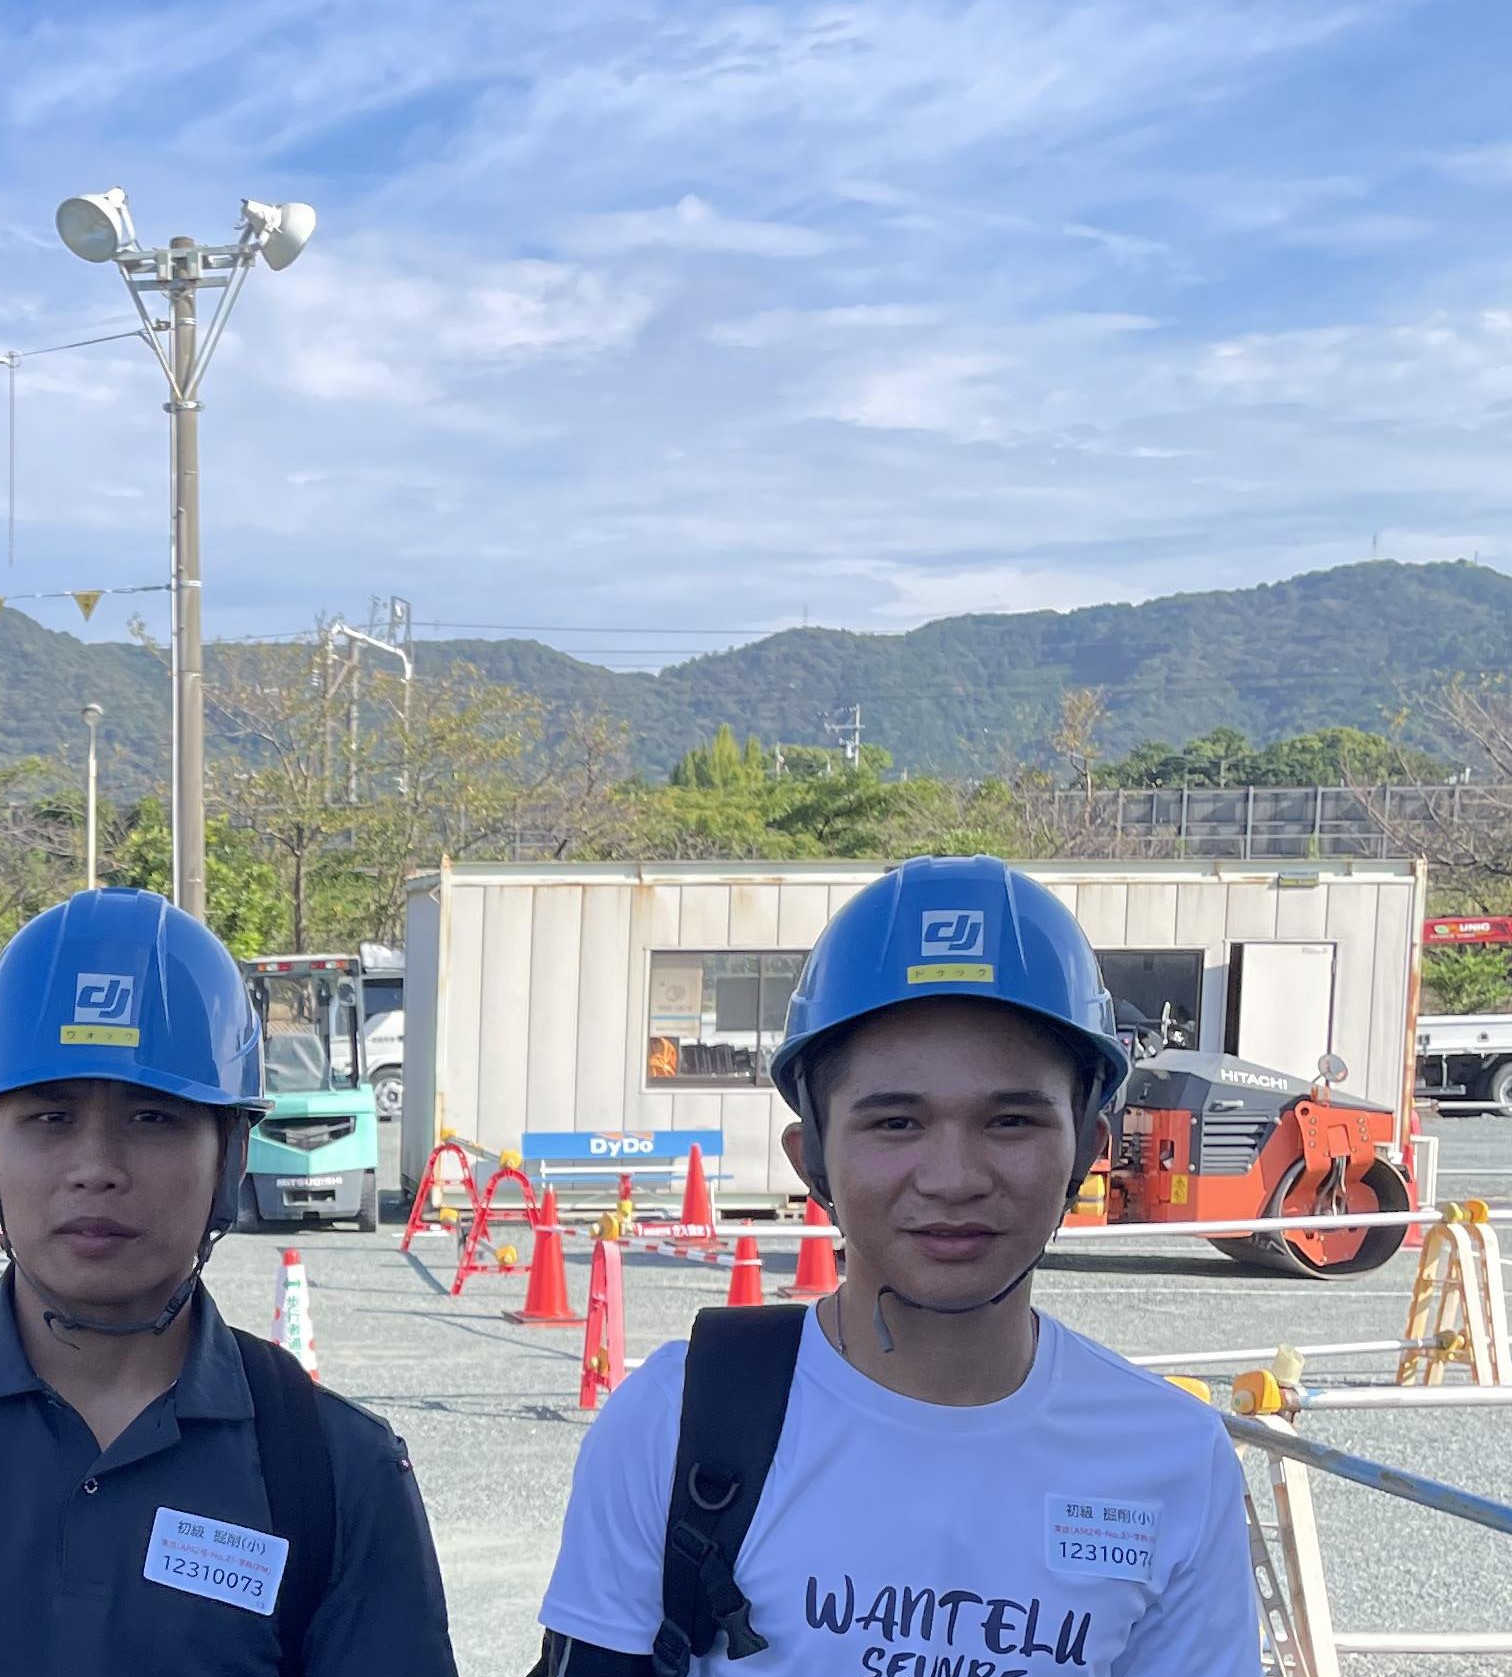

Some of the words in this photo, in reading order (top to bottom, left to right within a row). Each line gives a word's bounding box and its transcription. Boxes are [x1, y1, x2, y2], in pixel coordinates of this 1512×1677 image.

[1220, 1068, 1288, 1091] HITACHI
[589, 1137, 654, 1157] DyDo
[1066, 1503, 1093, 1519] 初級
[177, 1520, 205, 1539] 初級
[163, 1555, 264, 1597] 12310073
